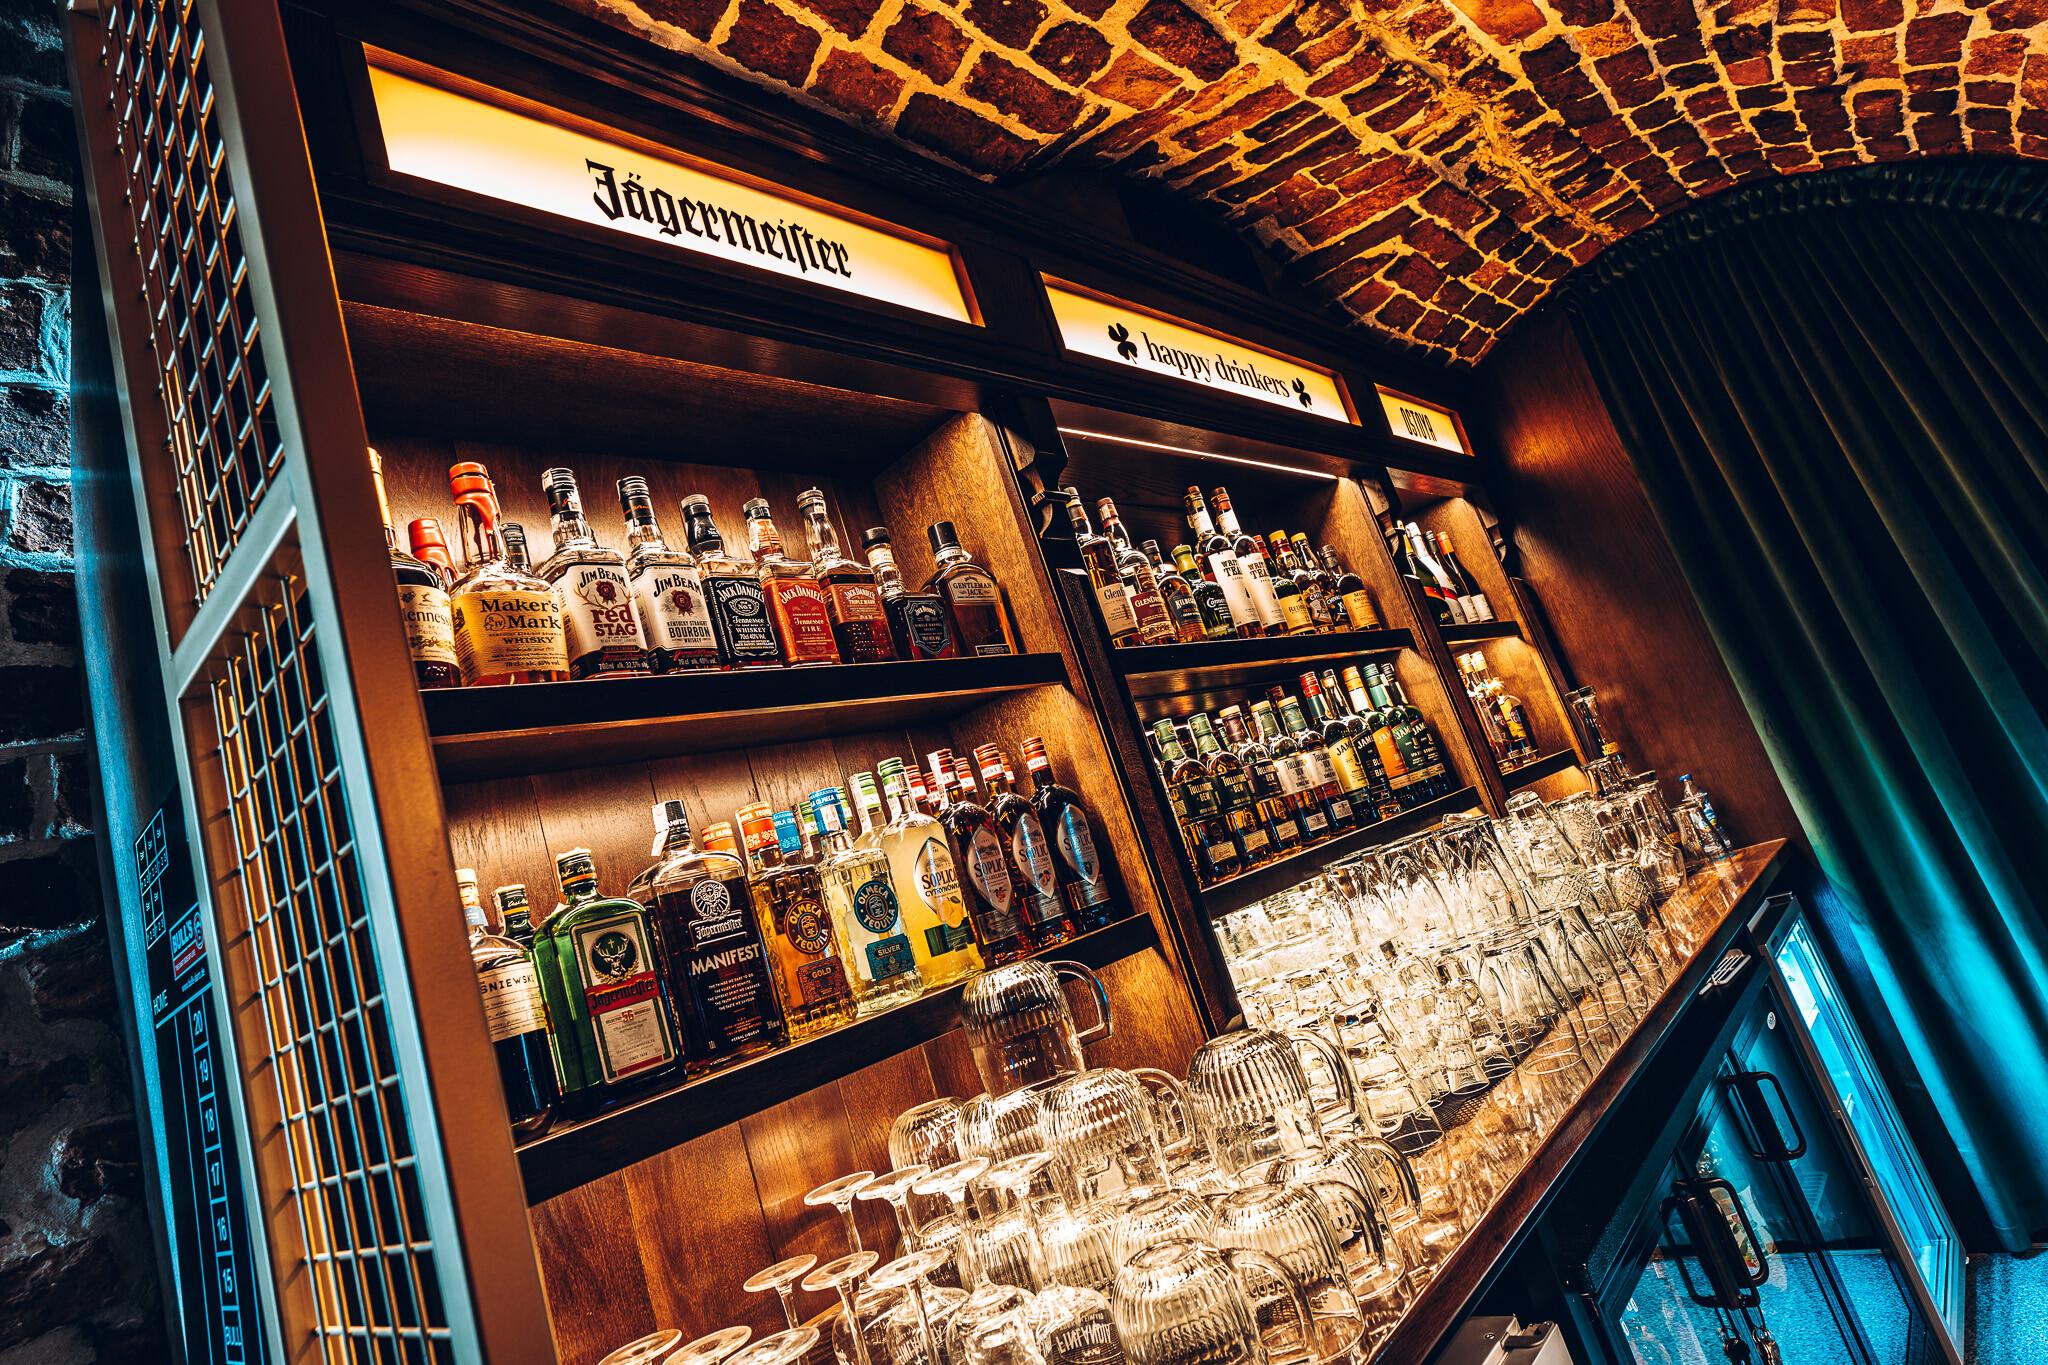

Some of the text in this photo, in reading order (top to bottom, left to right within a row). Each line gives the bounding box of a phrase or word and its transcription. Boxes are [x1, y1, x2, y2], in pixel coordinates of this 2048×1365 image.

[1140, 332, 1290, 398] happy drinkers
[1400, 407, 1437, 442] OSTOYA
[580, 567, 626, 588] JIM BEAM
[653, 574, 702, 597] JIM BEAM
[717, 586, 737, 603] JACK
[778, 586, 796, 604] JACK
[967, 588, 984, 596] JACK
[480, 598, 559, 613] Maker's
[590, 603, 635, 623] red
[507, 615, 562, 629] Mark
[594, 622, 637, 637] STAG
[731, 616, 764, 624] Tennessee
[793, 617, 824, 625] Tennessee
[503, 636, 555, 645] WHISKY
[668, 626, 711, 638] BOURBON
[858, 884, 889, 905] OLMECA
[789, 903, 822, 925] OLMECA
[863, 908, 896, 930] TEQUILA
[795, 928, 829, 951] TEQUILA
[877, 944, 901, 956] SILVER
[691, 943, 759, 976] MANIFEST
[812, 967, 832, 979] GOLD
[153, 989, 168, 1015] HOME
[193, 1010, 203, 1036] 20
[621, 1009, 634, 1023] 56
[199, 1059, 209, 1083] 19
[205, 1108, 215, 1133] 18
[210, 1161, 220, 1187] 17
[217, 1216, 227, 1241] 16
[222, 1268, 233, 1293] 15
[225, 1326, 242, 1346] BULL
